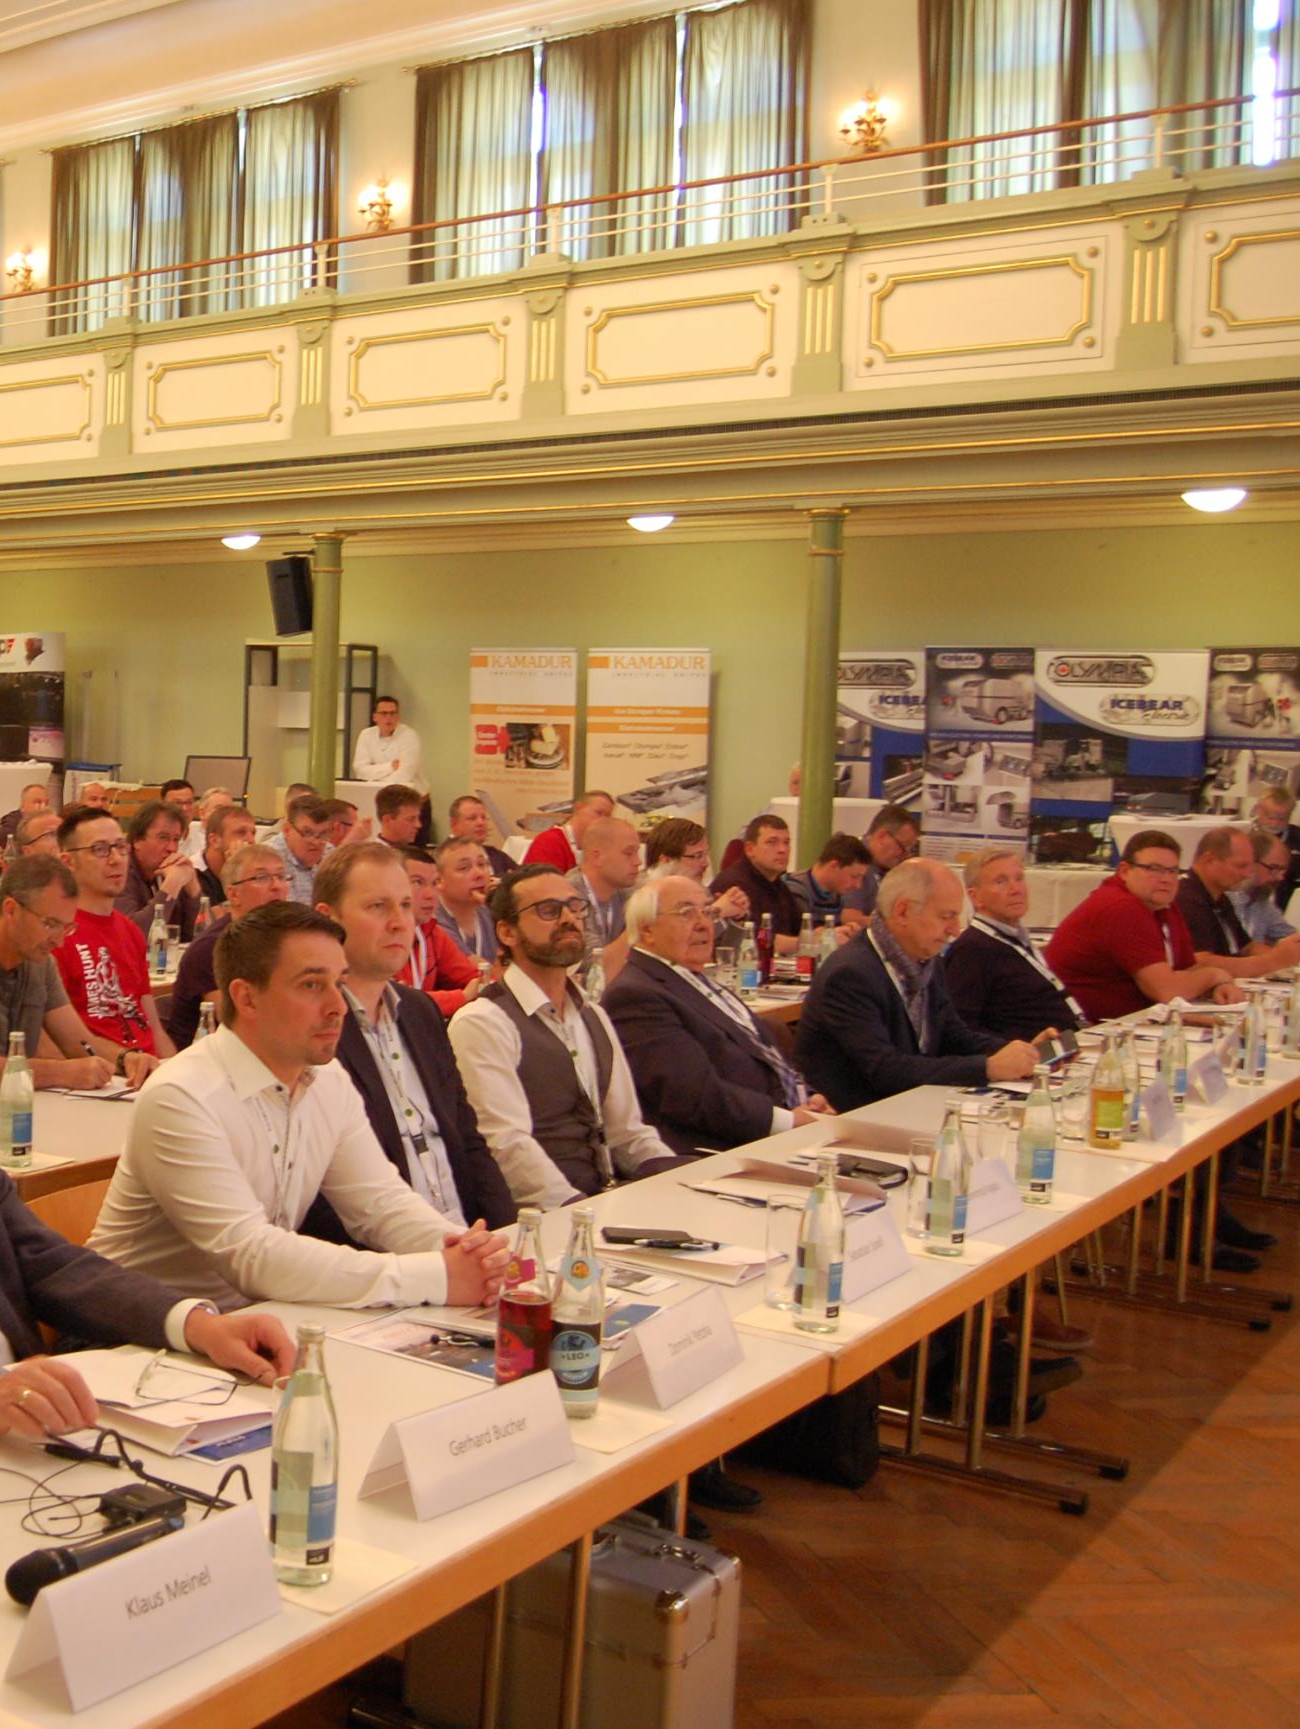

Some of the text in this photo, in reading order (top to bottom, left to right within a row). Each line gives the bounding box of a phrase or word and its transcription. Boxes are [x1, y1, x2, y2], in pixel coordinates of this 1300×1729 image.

[492, 655, 573, 669] KAMADUR
[613, 655, 706, 670] KAMADUR
[1110, 699, 1184, 711] ICEBEAR
[75, 943, 99, 980] HUNT
[566, 1351, 585, 1361] LEO
[448, 1415, 527, 1457] Gerhard Bucher
[124, 1563, 212, 1621] Klaus Meinel
